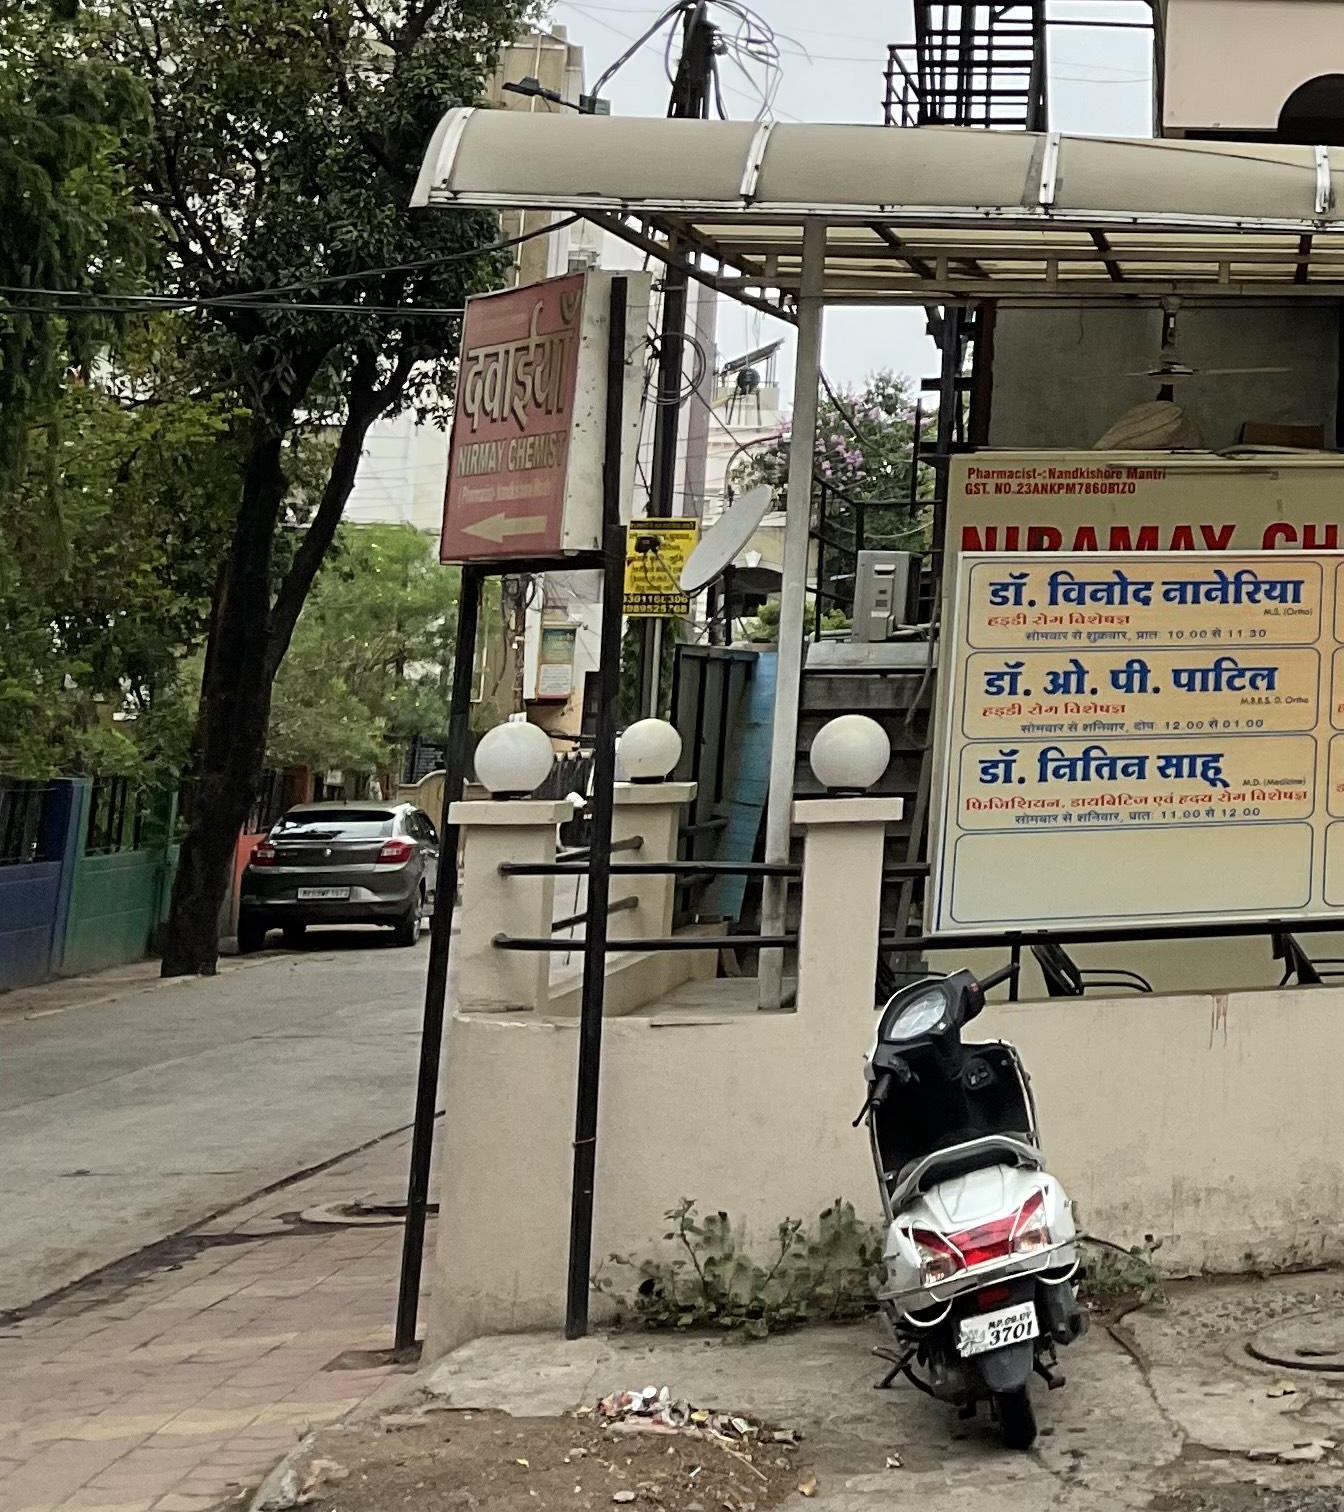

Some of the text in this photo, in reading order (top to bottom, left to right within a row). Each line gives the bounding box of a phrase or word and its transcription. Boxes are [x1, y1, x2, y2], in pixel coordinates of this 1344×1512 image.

[1127, 468, 1166, 479] Mantri
[989, 569, 1304, 607] डॉ. विनोद नानेरिया
[1032, 613, 1063, 625] रोग
[984, 656, 1278, 696] डॉ. ओ. पी. पाटिल
[1027, 702, 1058, 715] रोग
[979, 745, 1230, 788] डॉ. नितिन साहू
[1217, 789, 1246, 803] रोग
[990, 1321, 1032, 1346] 3701
